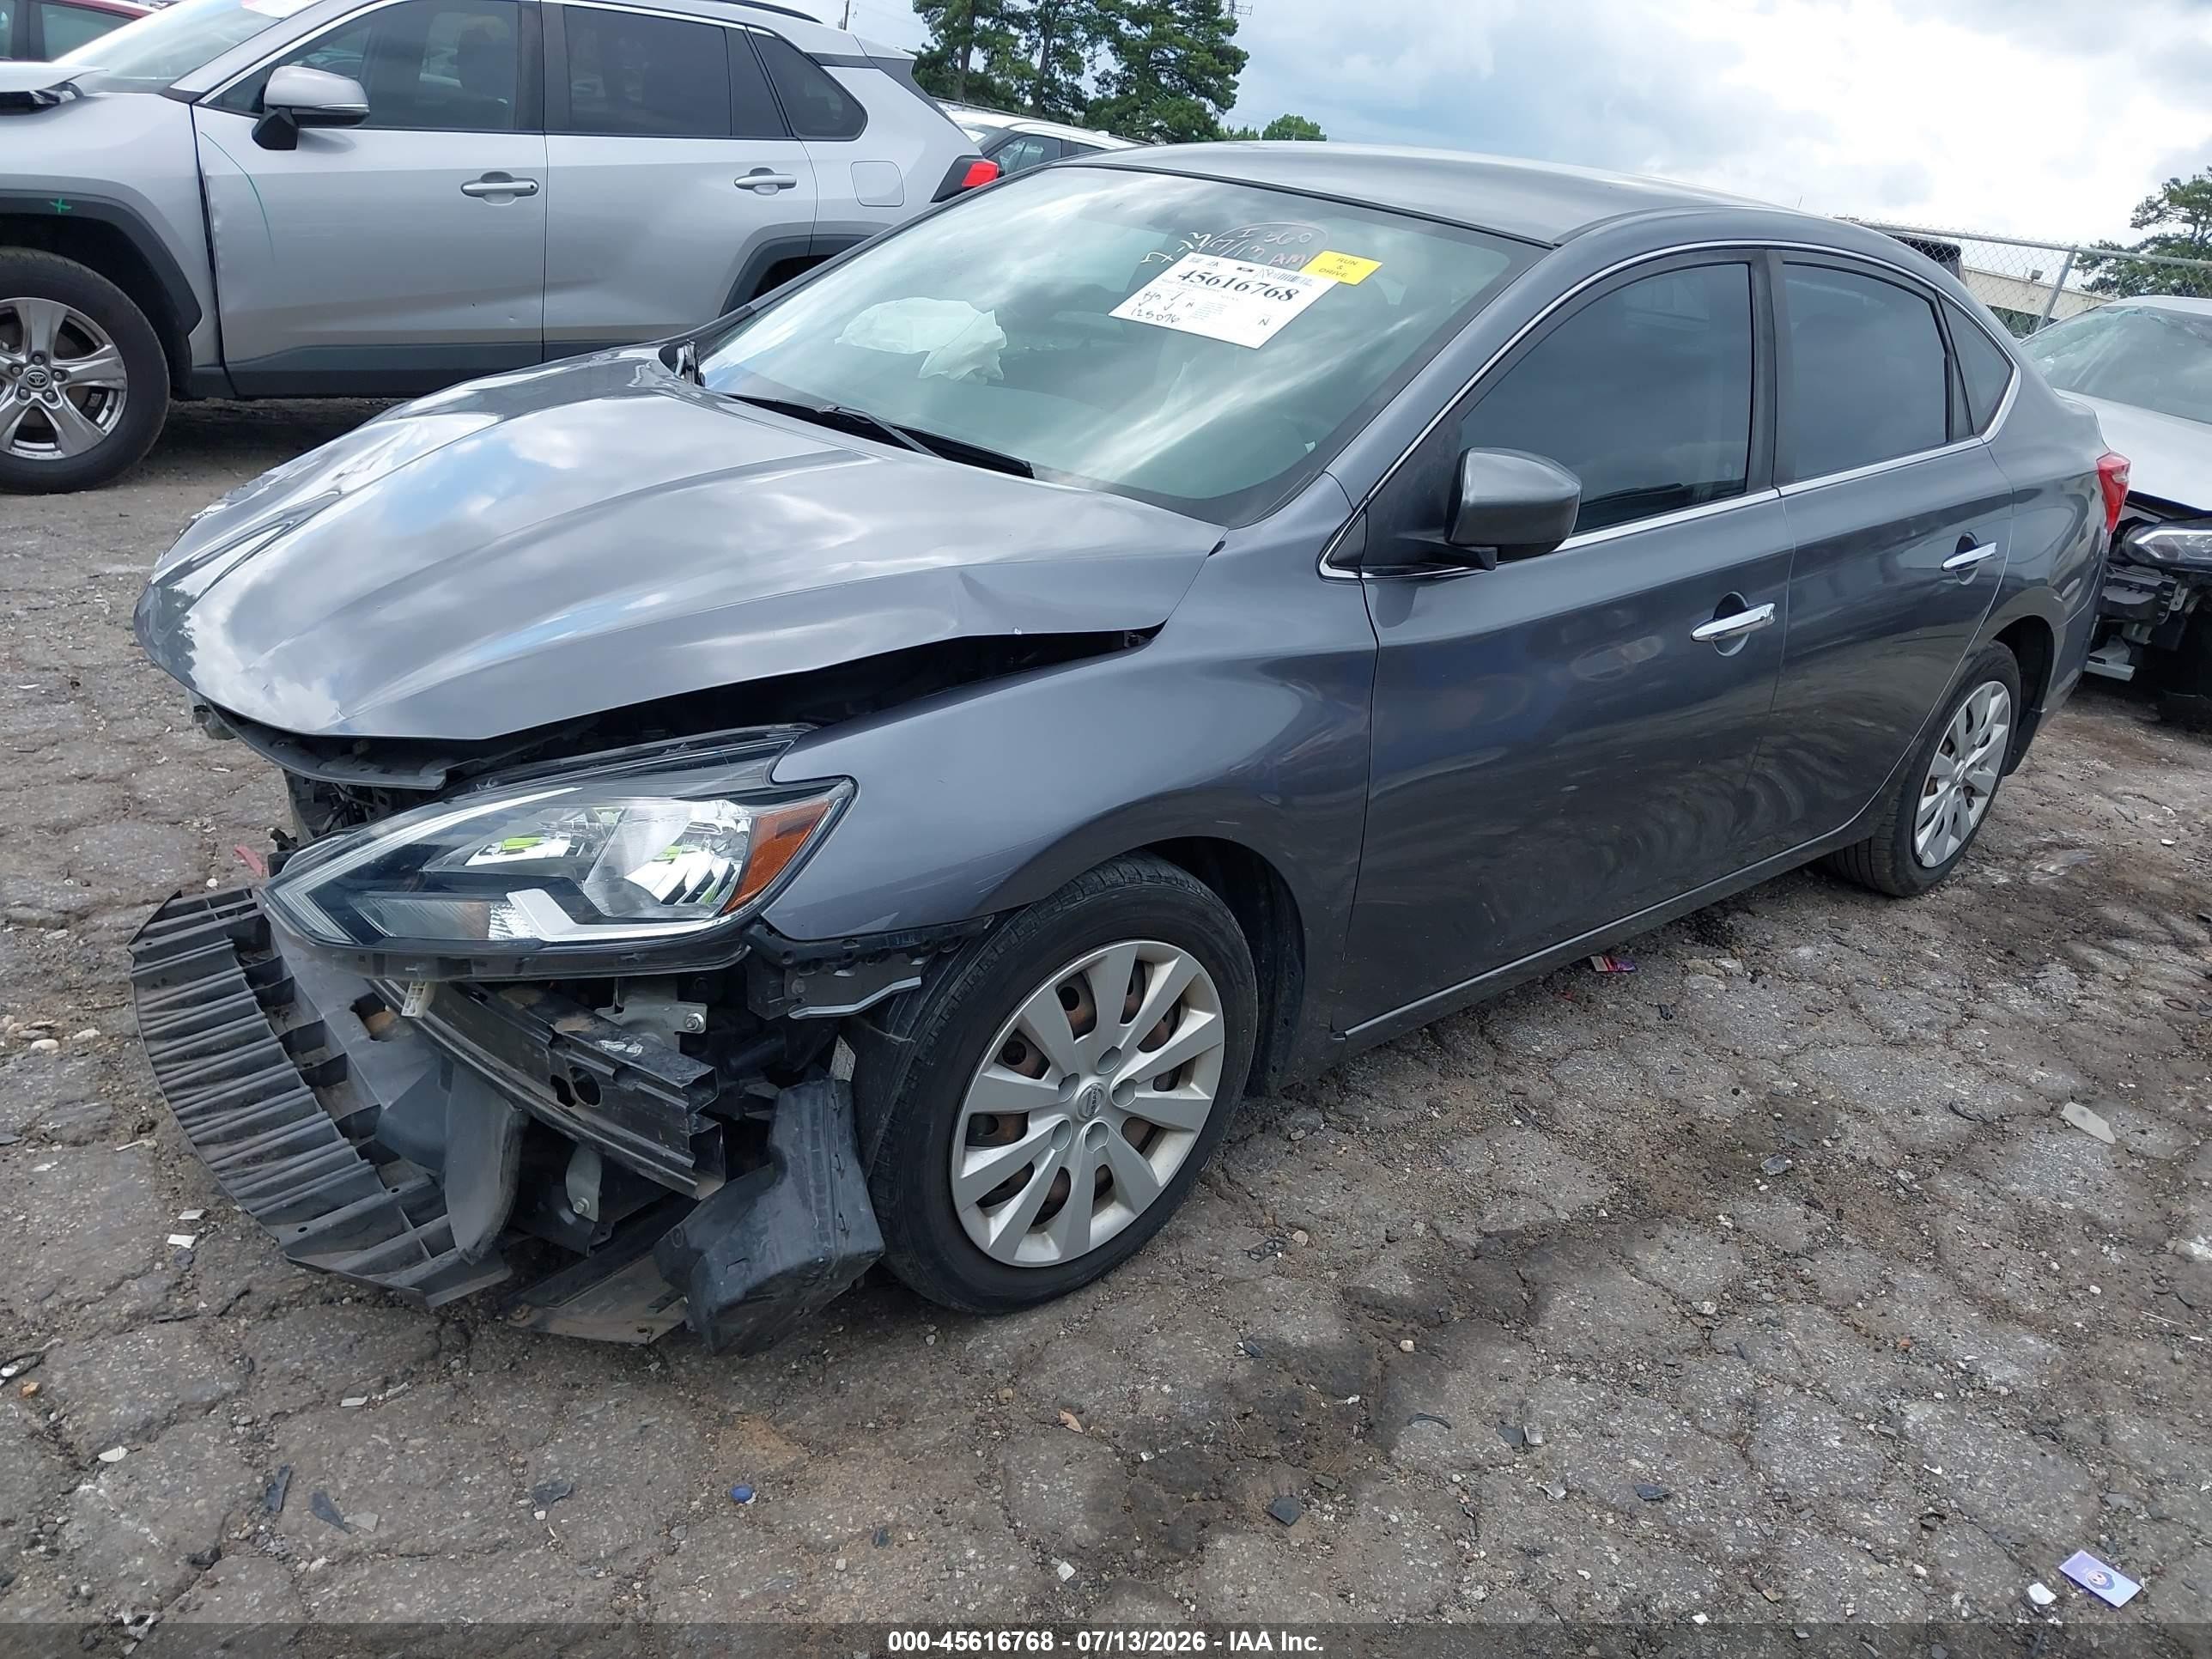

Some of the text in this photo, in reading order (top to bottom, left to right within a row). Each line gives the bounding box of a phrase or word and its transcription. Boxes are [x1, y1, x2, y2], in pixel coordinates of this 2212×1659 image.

[1335, 258, 1358, 266] RUN
[1319, 267, 1348, 278] DRIVE
[1177, 270, 1300, 301] 45616768
